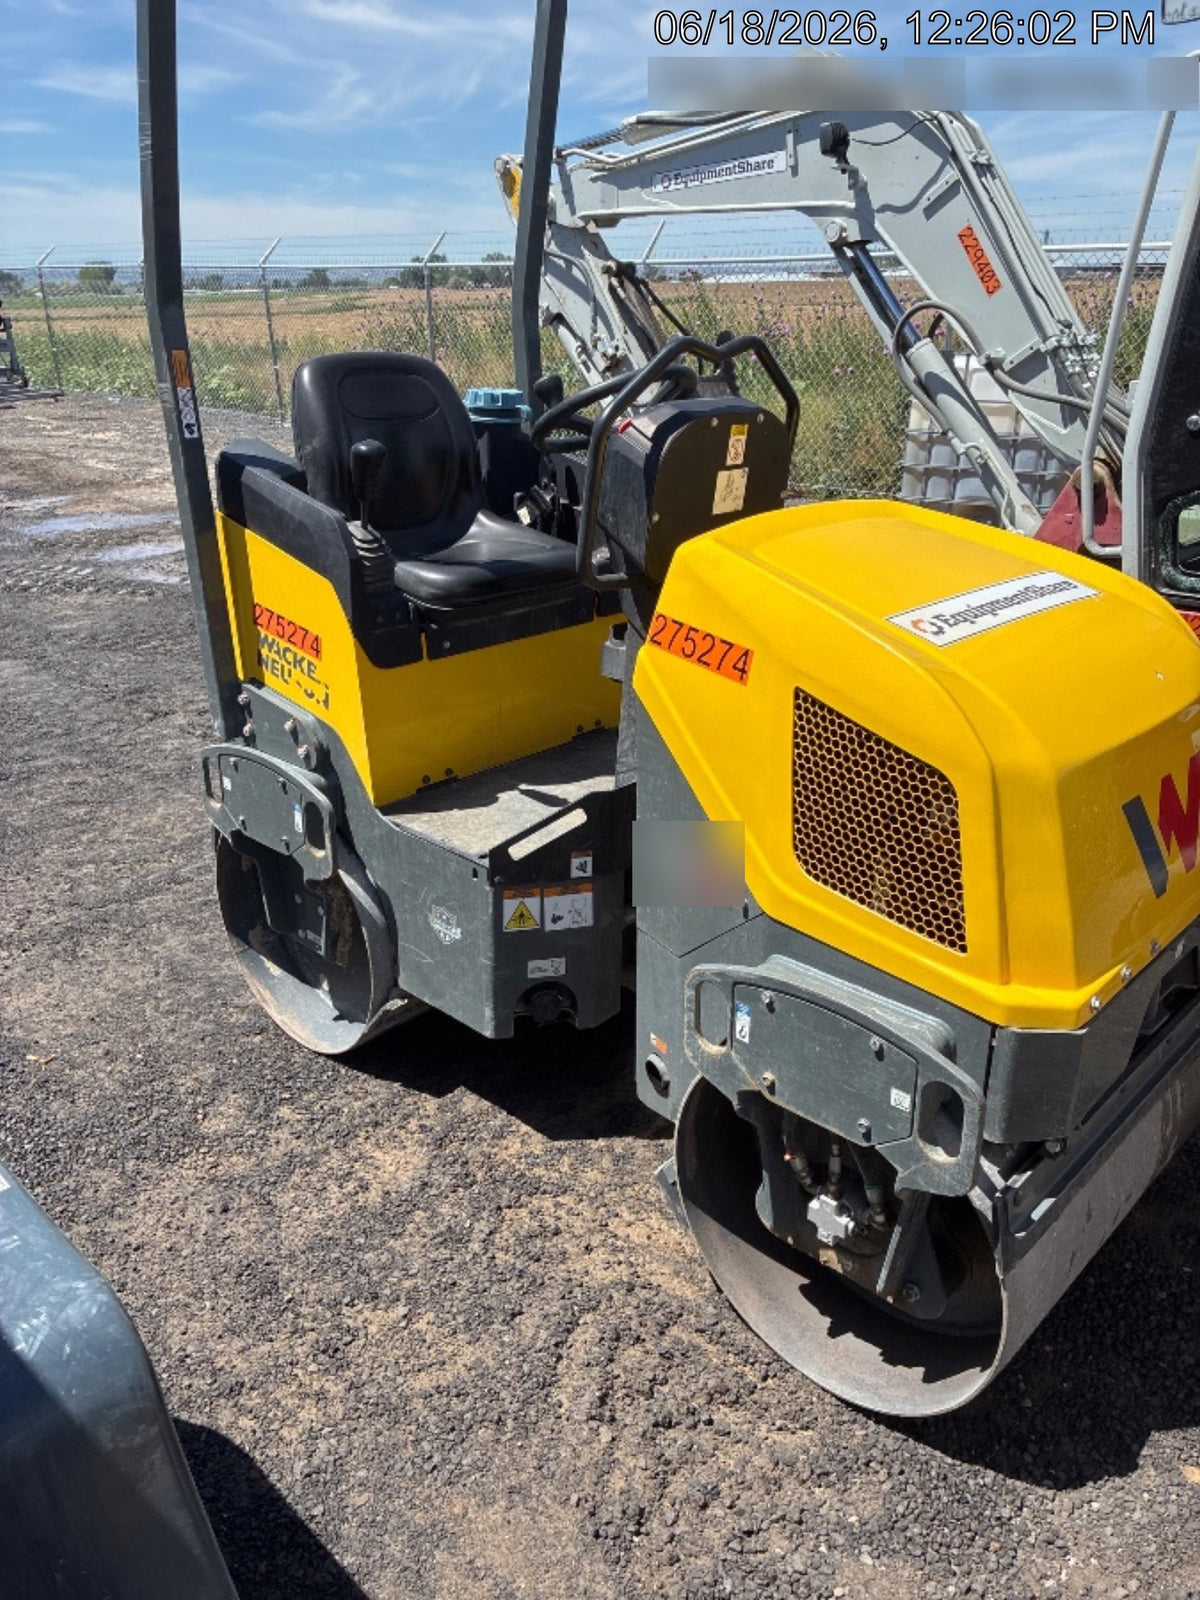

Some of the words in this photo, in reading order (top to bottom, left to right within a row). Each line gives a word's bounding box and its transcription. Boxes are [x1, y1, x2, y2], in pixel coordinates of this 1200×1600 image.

[673, 157, 775, 188] EquipmentShare
[957, 225, 1002, 294] 229403
[253, 602, 321, 659] 275274
[932, 579, 1079, 629] EquipmentShare
[650, 613, 749, 681] 275274
